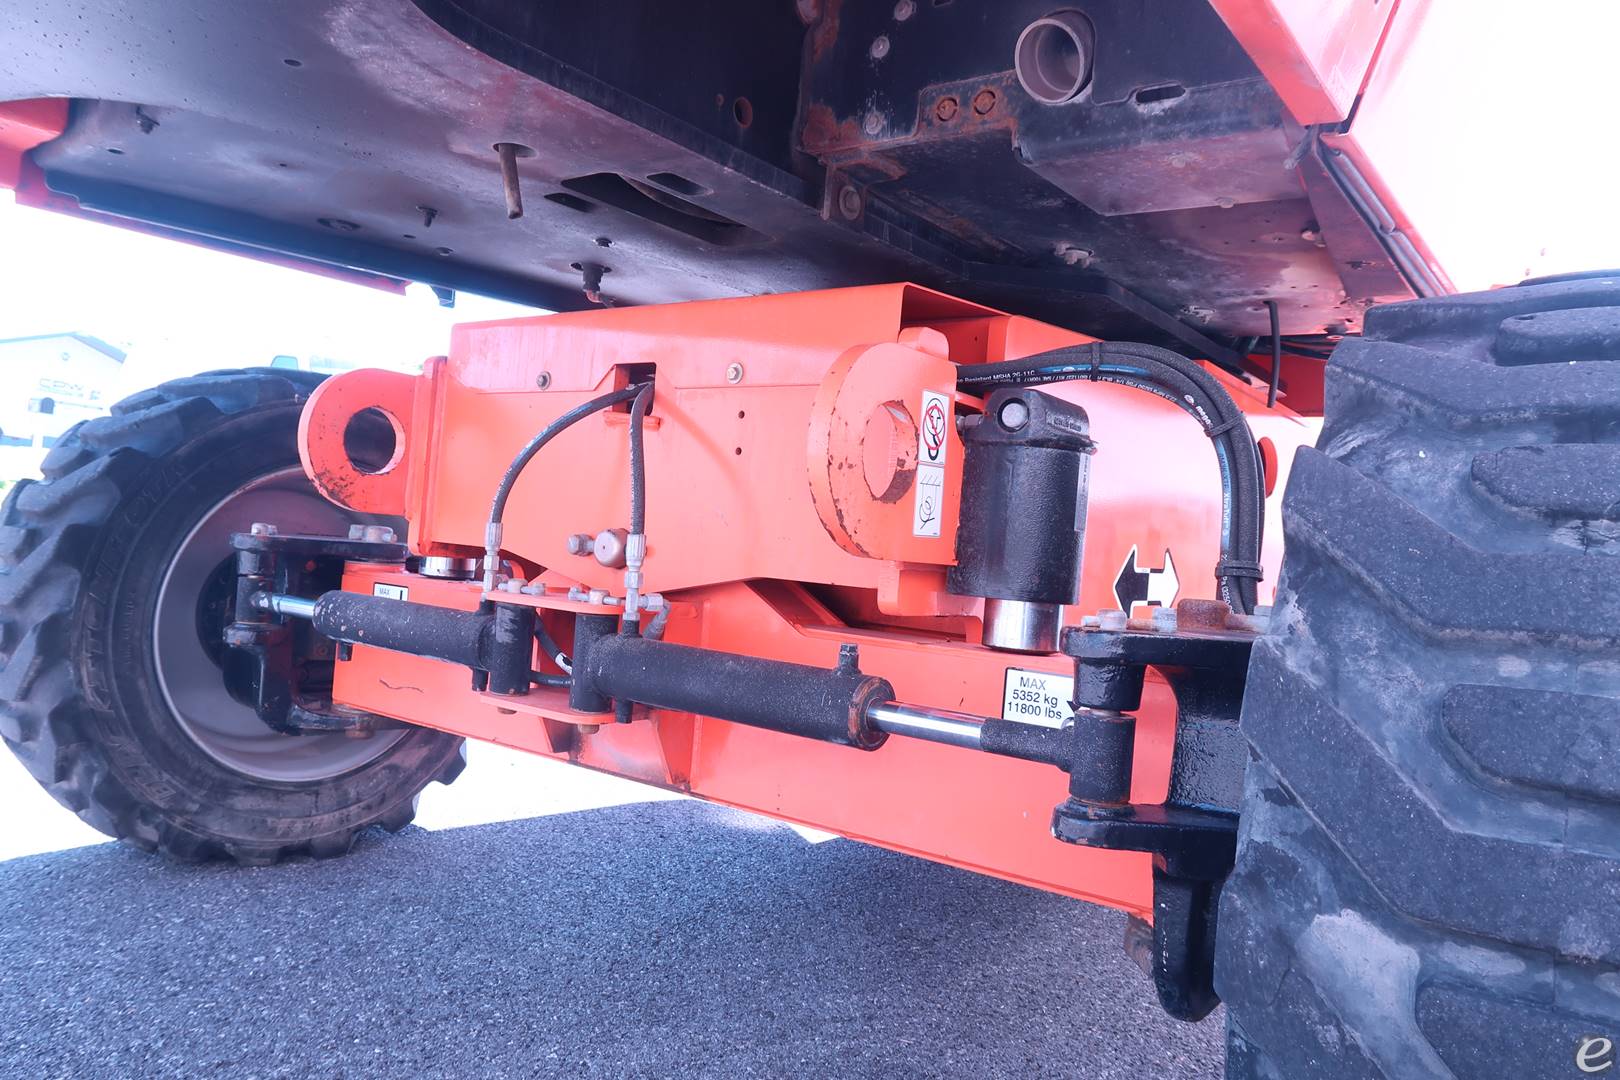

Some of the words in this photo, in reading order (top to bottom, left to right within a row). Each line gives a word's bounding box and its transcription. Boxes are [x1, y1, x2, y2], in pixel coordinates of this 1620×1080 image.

[1019, 676, 1047, 691] MAX
[1012, 689, 1041, 703] 5352
[1043, 693, 1058, 709] kg
[1007, 701, 1042, 716] 11800
[1044, 706, 1062, 720] lbs
